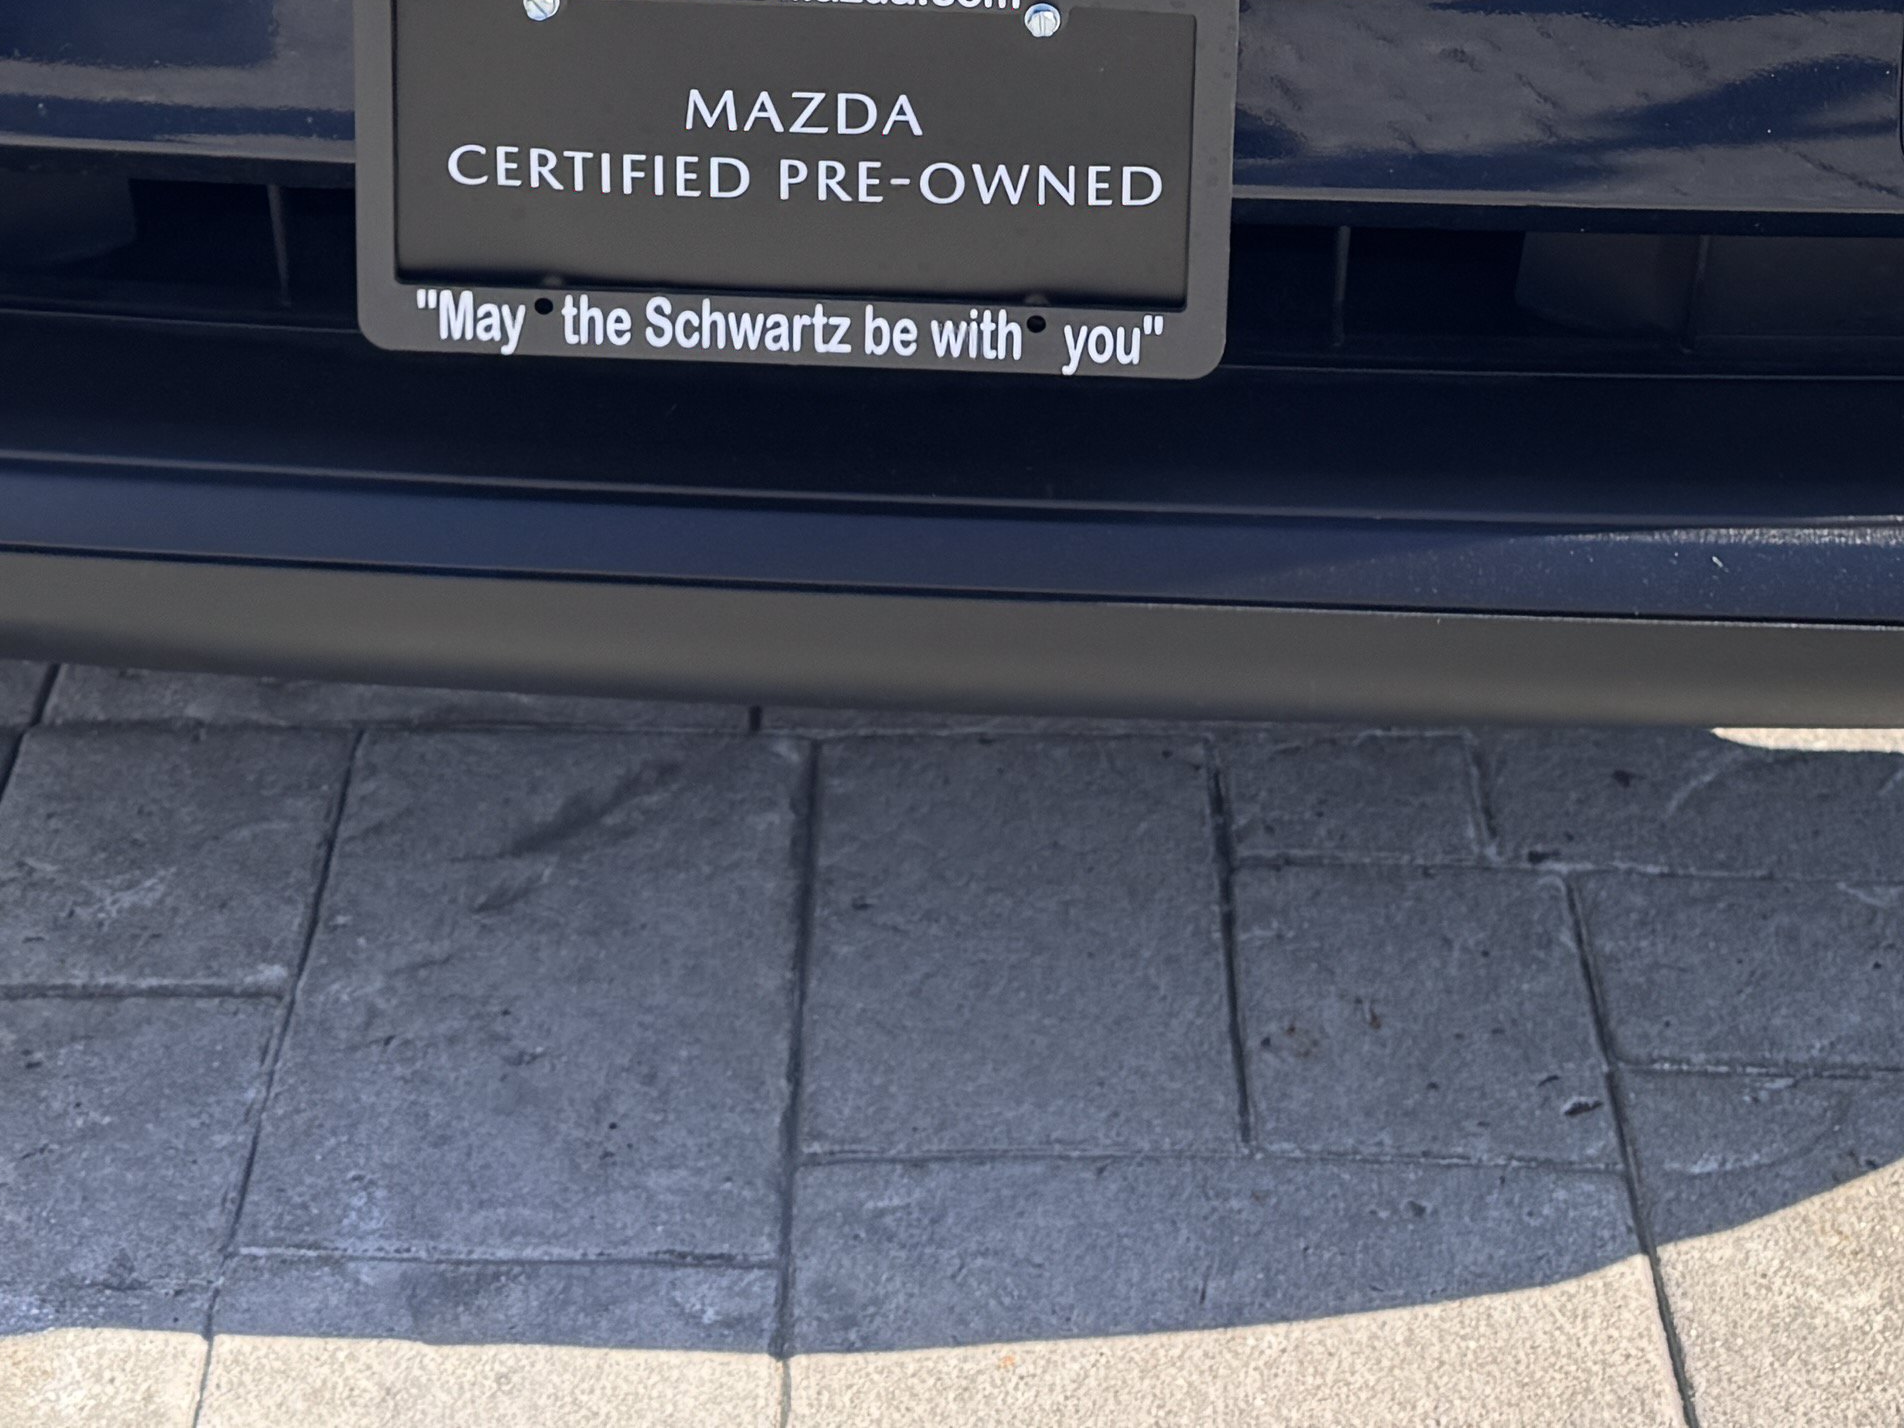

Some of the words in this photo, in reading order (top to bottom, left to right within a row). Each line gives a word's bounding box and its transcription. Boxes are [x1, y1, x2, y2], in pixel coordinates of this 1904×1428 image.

[684, 88, 924, 136] MAZDA
[447, 144, 751, 200] CERTIFIED
[778, 158, 1164, 208] PRE-OWNED
[415, 289, 528, 356] "May
[561, 294, 633, 343] the
[643, 297, 852, 354] Schwartz
[864, 307, 918, 355] be
[931, 309, 1023, 361] with
[1060, 316, 1164, 376] you"
